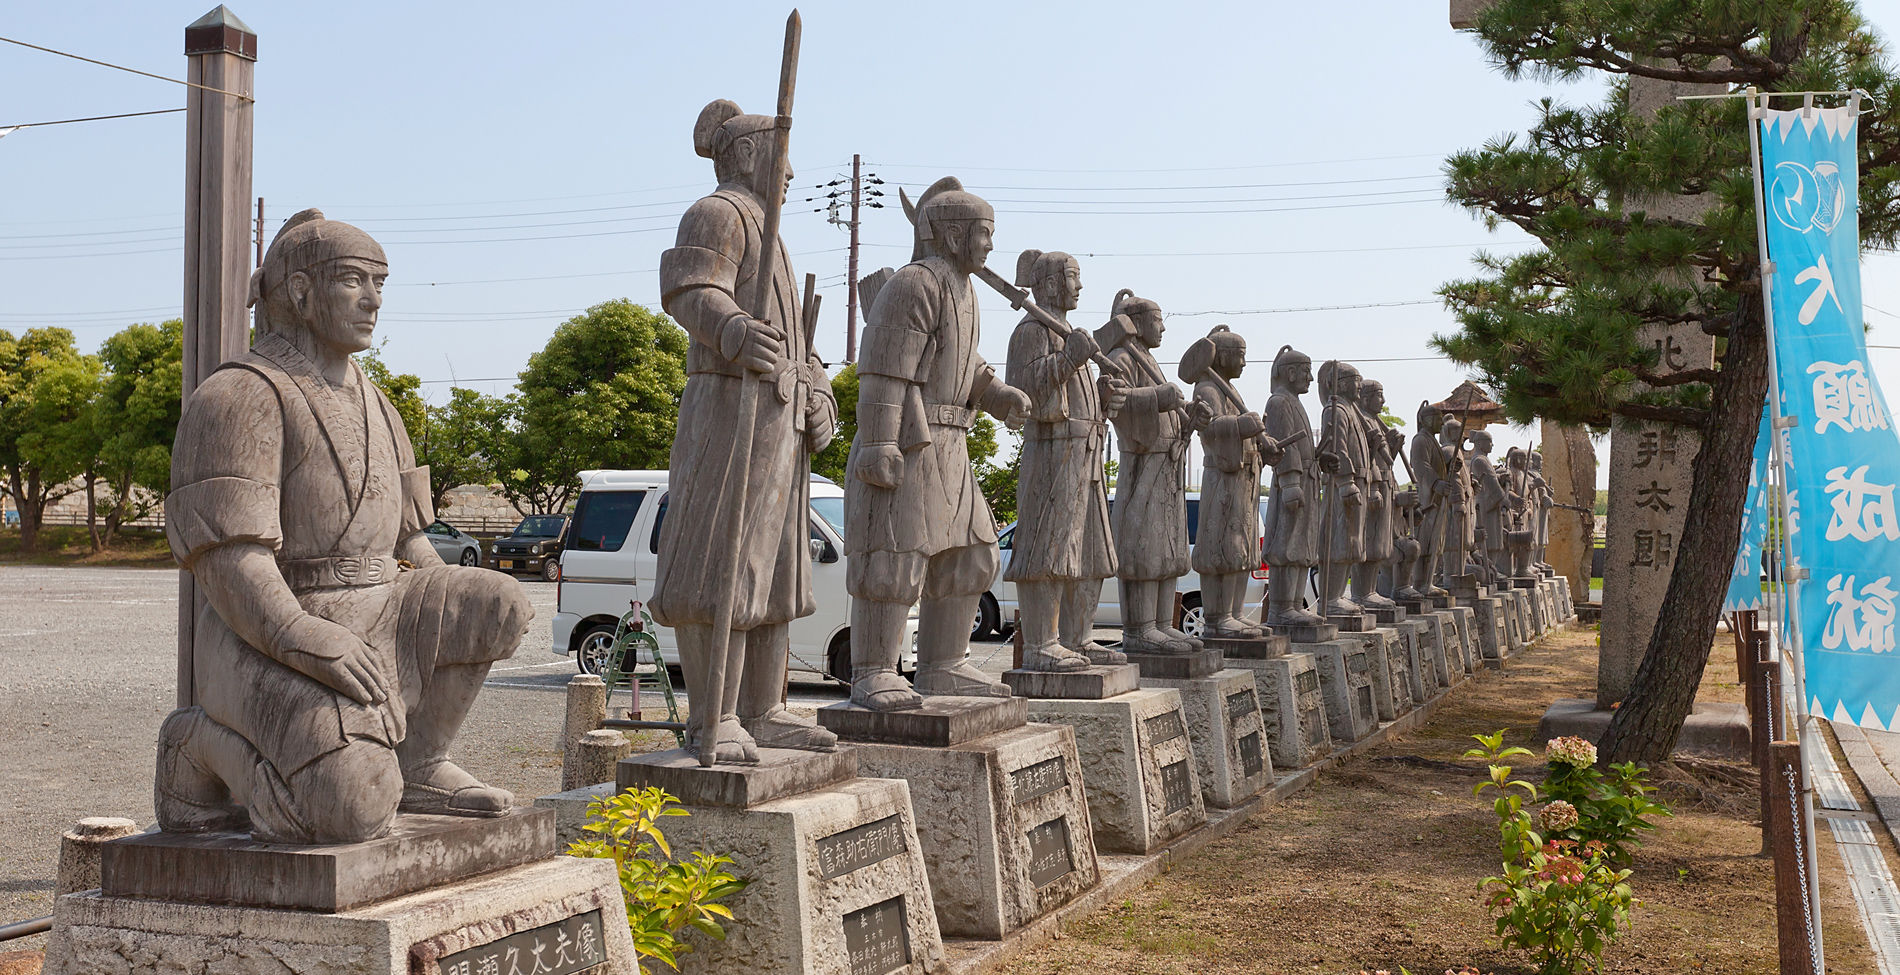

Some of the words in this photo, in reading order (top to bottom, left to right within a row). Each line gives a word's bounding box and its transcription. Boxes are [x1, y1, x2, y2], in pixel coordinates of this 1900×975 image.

[821, 823, 902, 874] 富森助右衛門像
